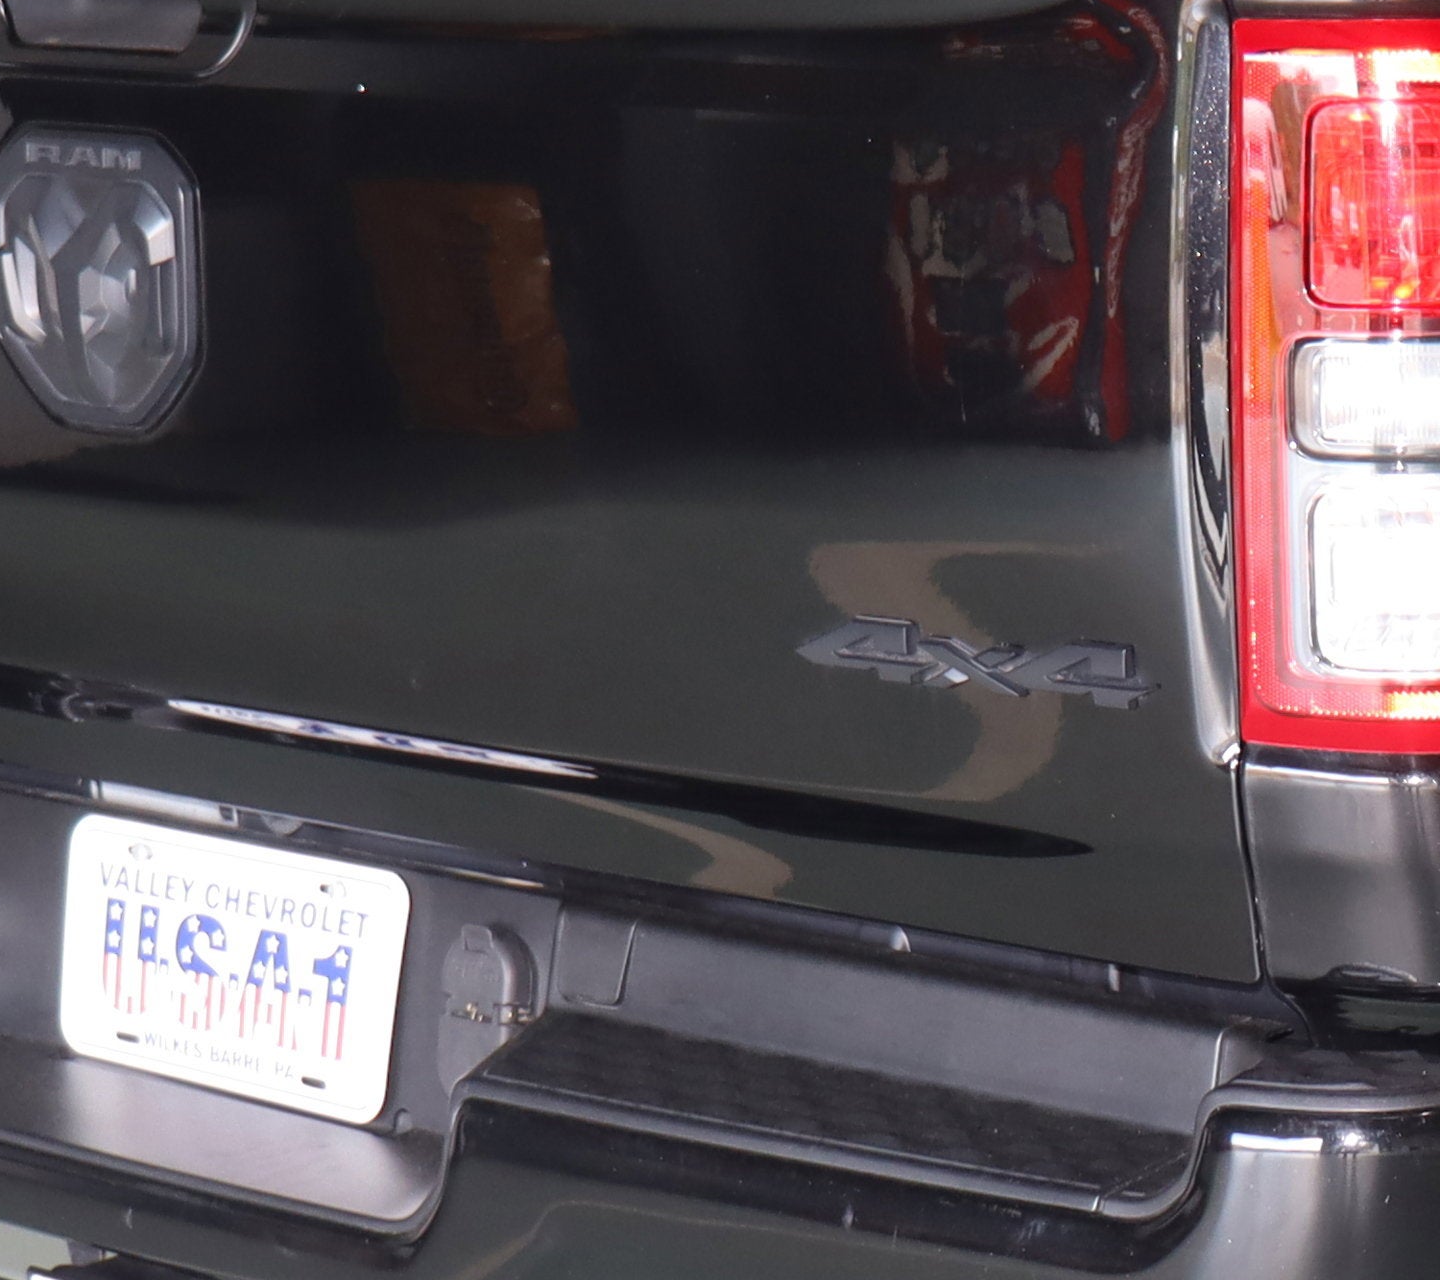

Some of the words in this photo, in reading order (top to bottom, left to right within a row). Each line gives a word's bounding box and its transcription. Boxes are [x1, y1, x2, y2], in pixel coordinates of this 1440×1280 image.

[25, 141, 142, 170] RAM
[99, 862, 195, 904] VALLEY
[204, 882, 369, 939] CHEVROLET
